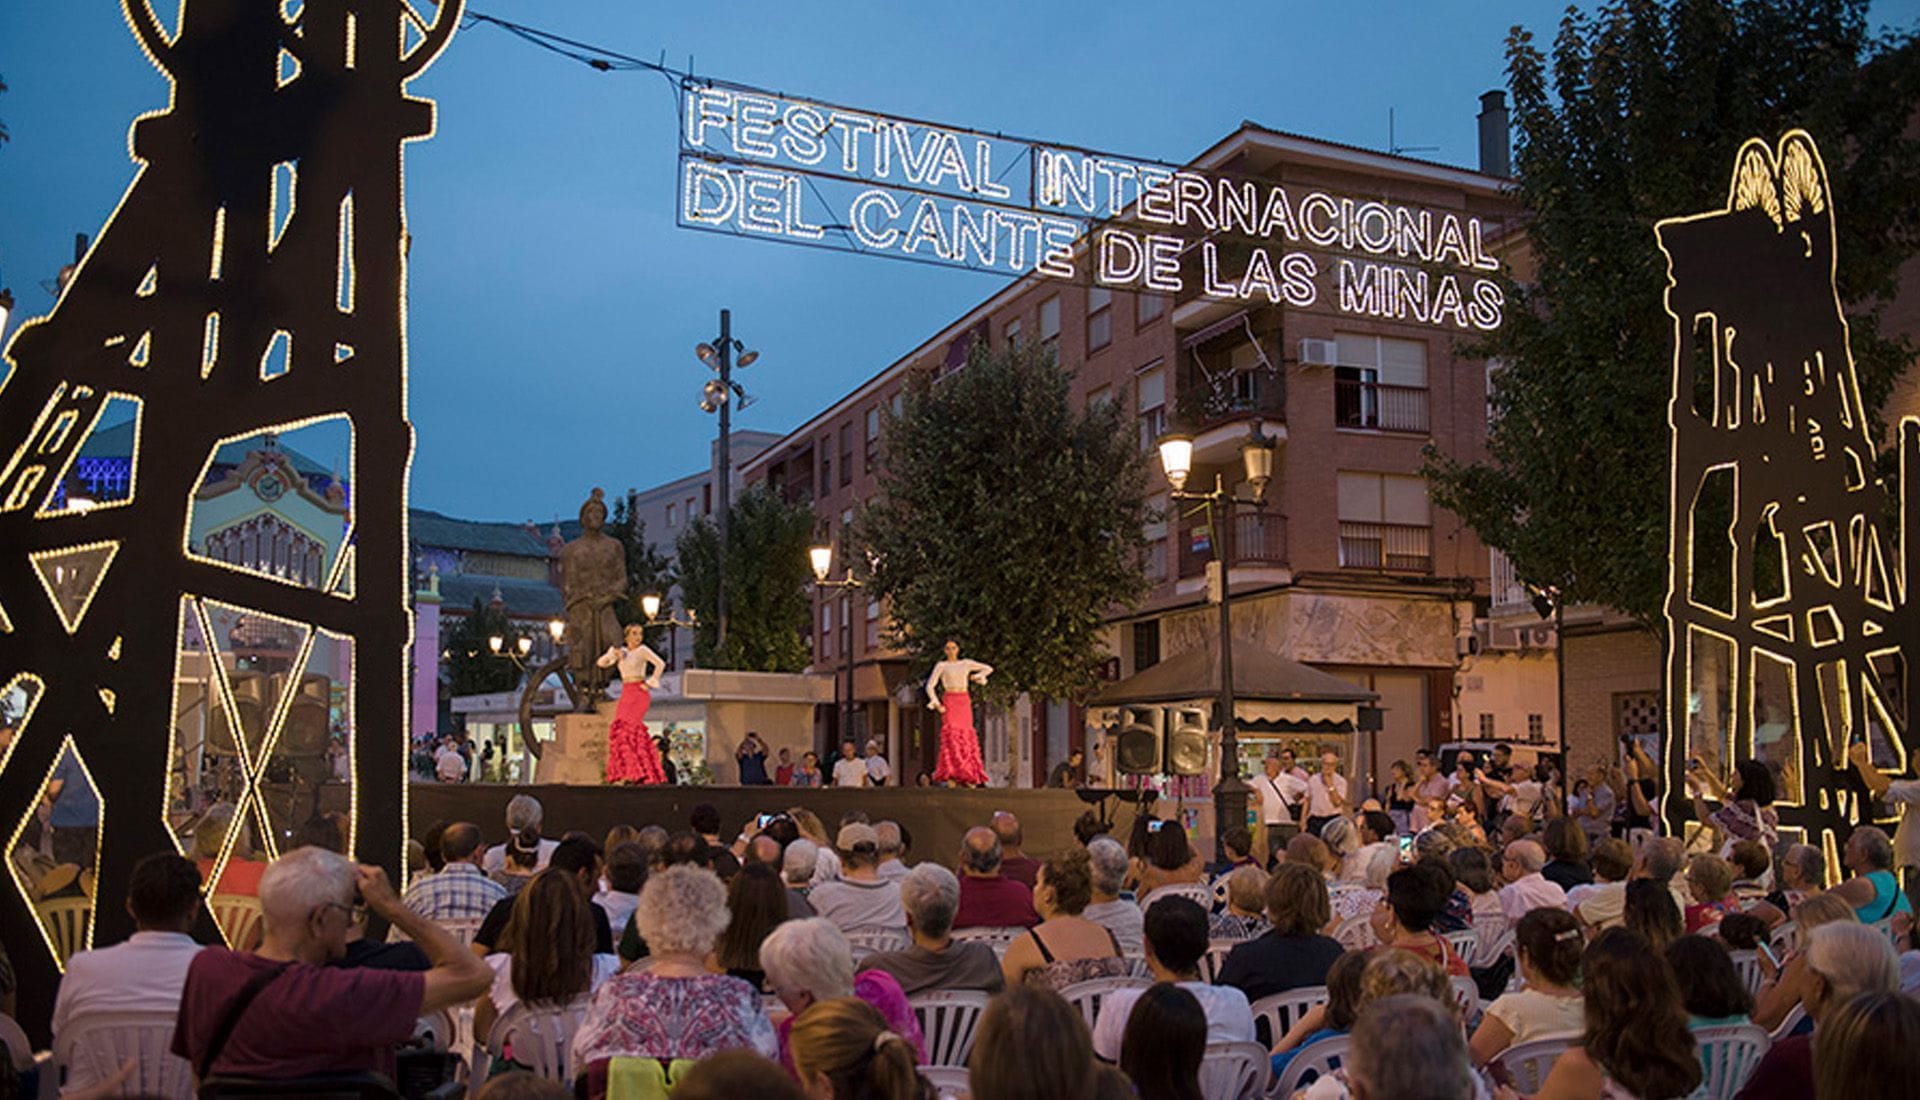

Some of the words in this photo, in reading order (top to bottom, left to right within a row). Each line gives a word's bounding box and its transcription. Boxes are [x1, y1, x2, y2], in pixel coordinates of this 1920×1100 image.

[684, 161, 824, 240] DEL
[849, 188, 1080, 278] CANTE
[1099, 229, 1184, 292] DE
[1203, 240, 1318, 306] LAS
[1338, 259, 1505, 330] MINAS
[686, 86, 1010, 199] FESTIVAL
[1038, 150, 1499, 271] INTERNACIONAL
